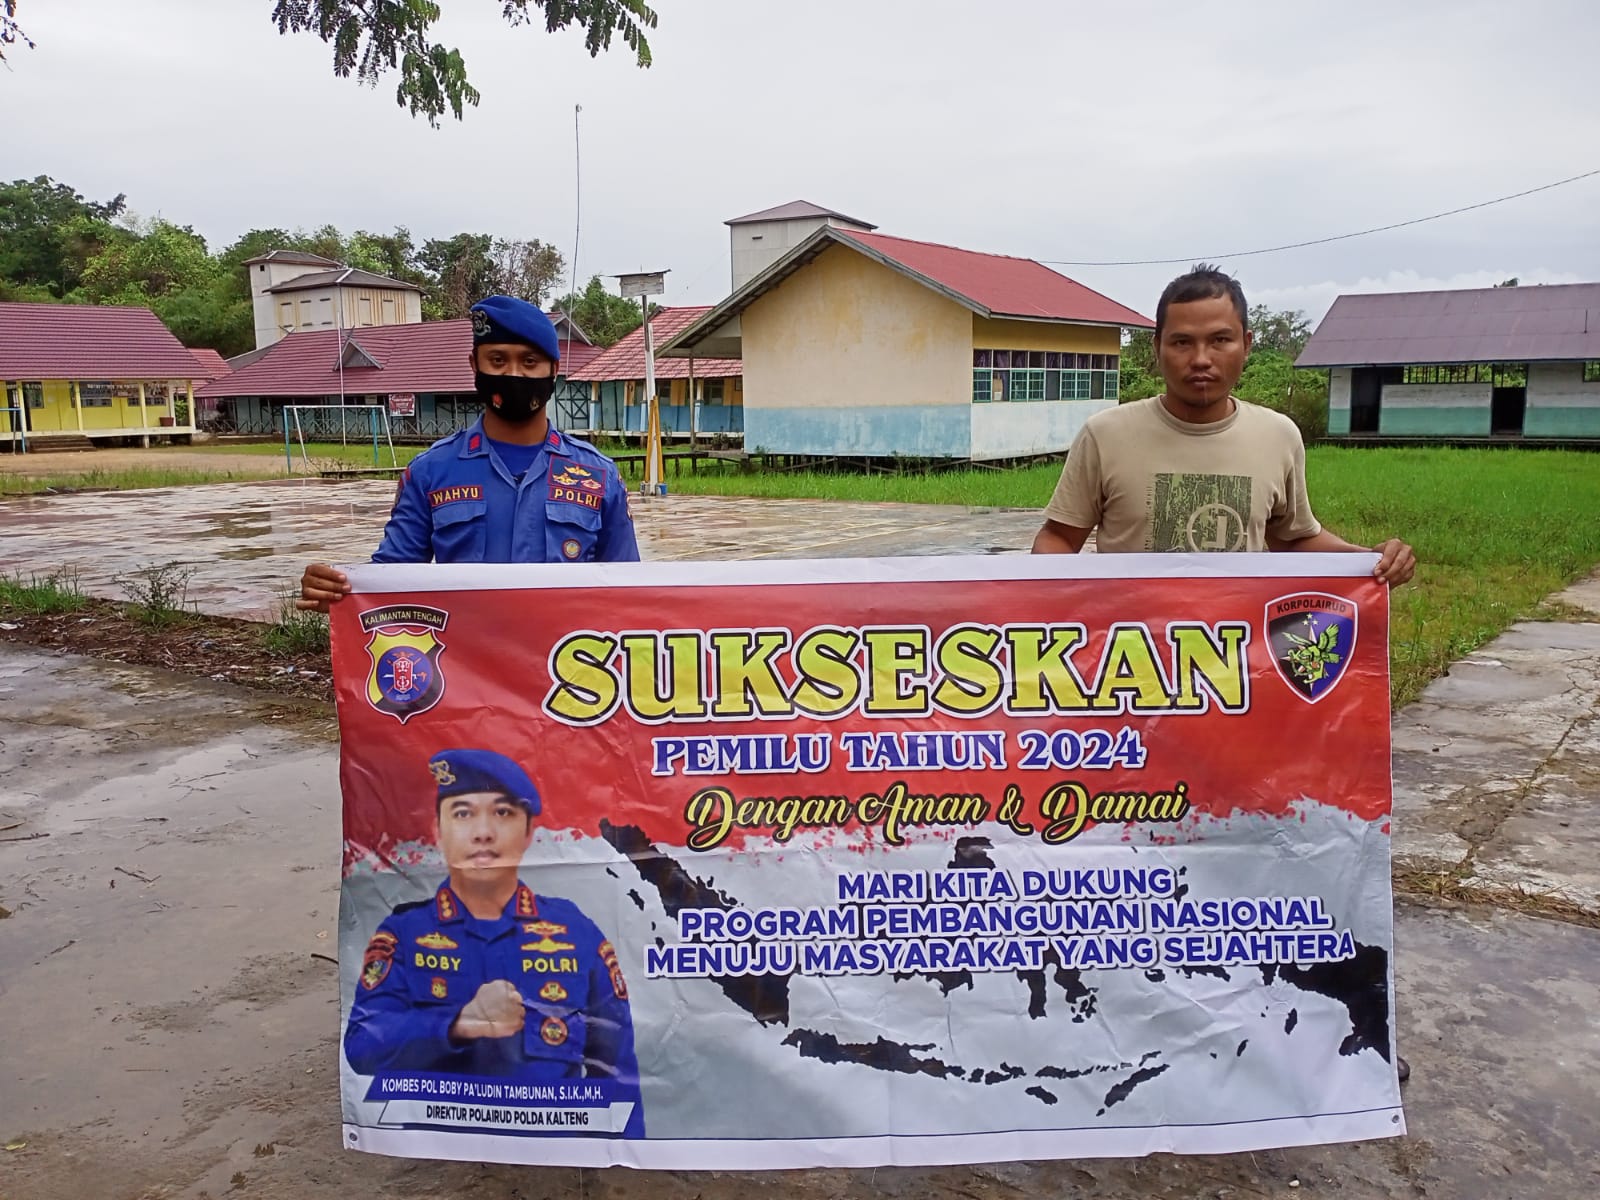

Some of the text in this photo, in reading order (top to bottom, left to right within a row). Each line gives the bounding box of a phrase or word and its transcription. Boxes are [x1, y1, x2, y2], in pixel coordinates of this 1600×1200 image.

[432, 488, 480, 504] WAHYU
[554, 488, 598, 508] POLRI
[1277, 599, 1347, 613] KORPOLAIRUD
[364, 610, 443, 625] KALIMANTAN TENGAH
[544, 624, 1249, 721] SUKSESKAN
[652, 728, 1144, 774] PEMILU TAHUN 2024
[686, 781, 1188, 849] Dengan Aman & Damai
[837, 867, 1172, 901] MARI KITA DUKUNG
[680, 899, 1330, 939] PROGRAM PEMBANGUNAN NASIONAL
[414, 952, 461, 972] BOBY
[646, 931, 1355, 975] MENUJU MASYARAKAT YANG SEJAHTERA
[522, 957, 579, 974] POLRI
[382, 1078, 419, 1093] KOMBES
[421, 1080, 437, 1094] POL
[439, 1080, 462, 1095] BOBY
[463, 1083, 503, 1099] PA'LUDIN
[504, 1085, 558, 1102] TAMBUNAN,
[426, 1105, 589, 1125] DIREKTUR POLAIRUD POLDA KALTENG
